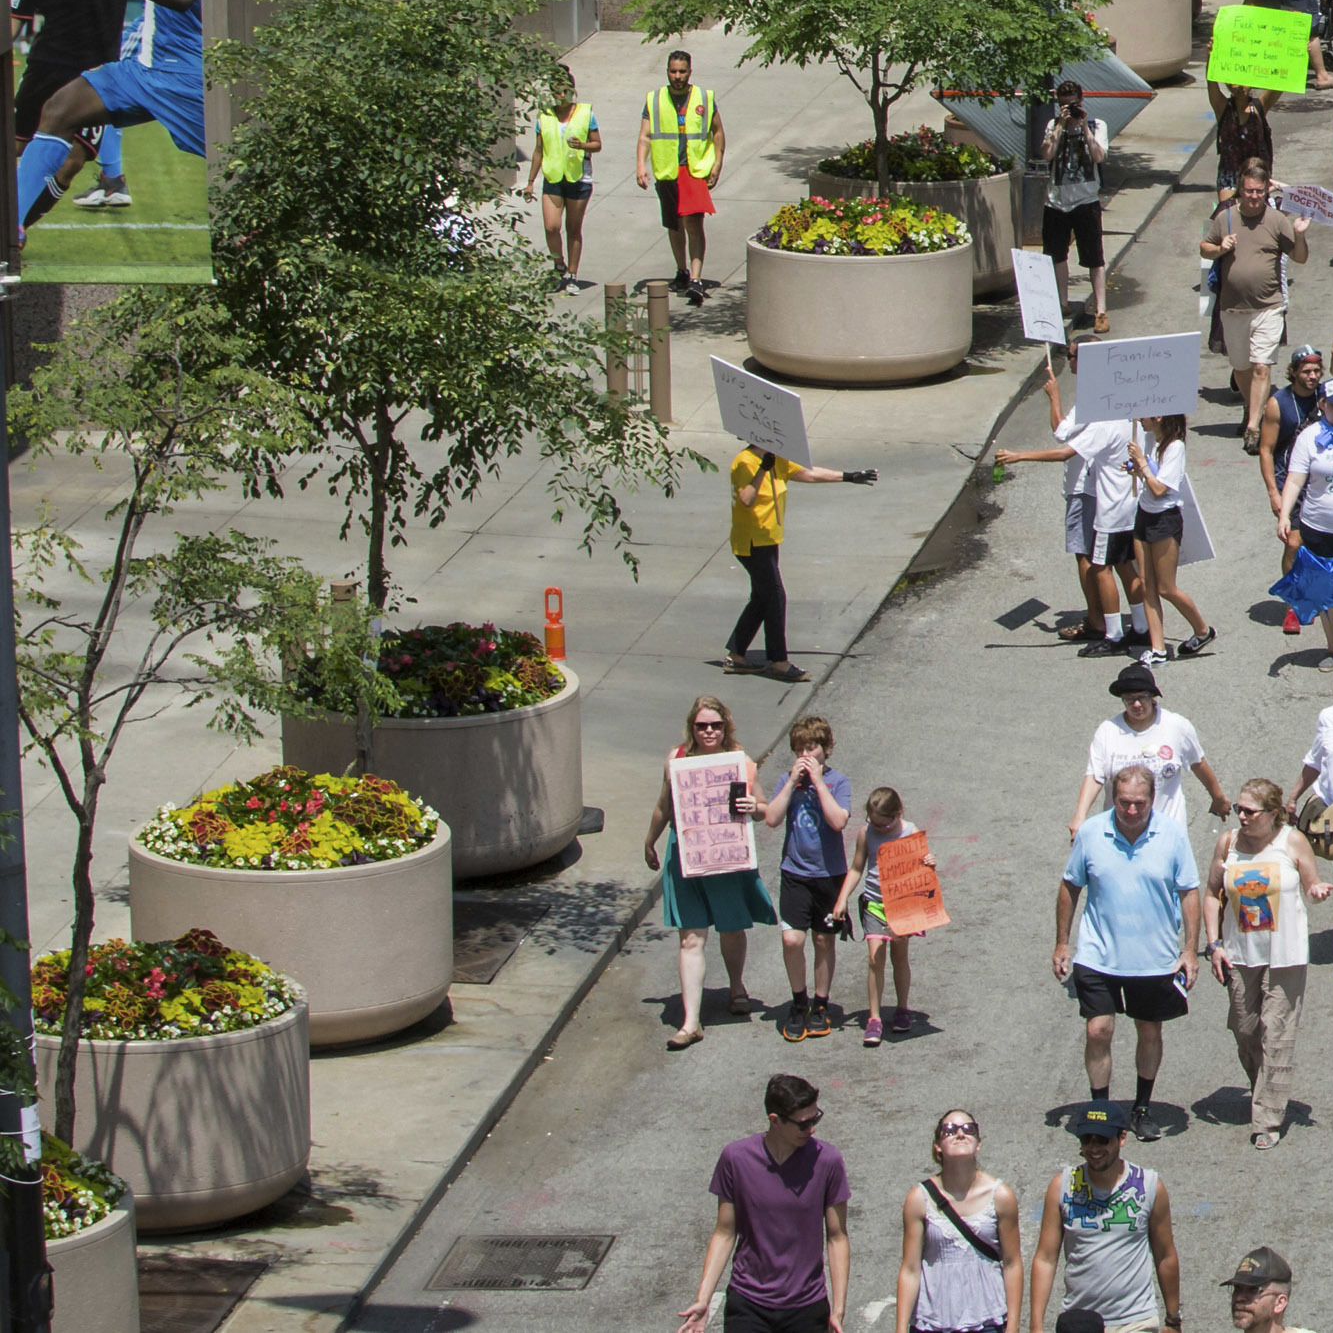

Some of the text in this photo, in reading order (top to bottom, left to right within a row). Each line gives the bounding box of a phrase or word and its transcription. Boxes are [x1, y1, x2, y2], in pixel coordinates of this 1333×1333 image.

[1107, 346, 1172, 365] Families
[1113, 370, 1160, 388] Belong
[1100, 393, 1176, 415] Together
